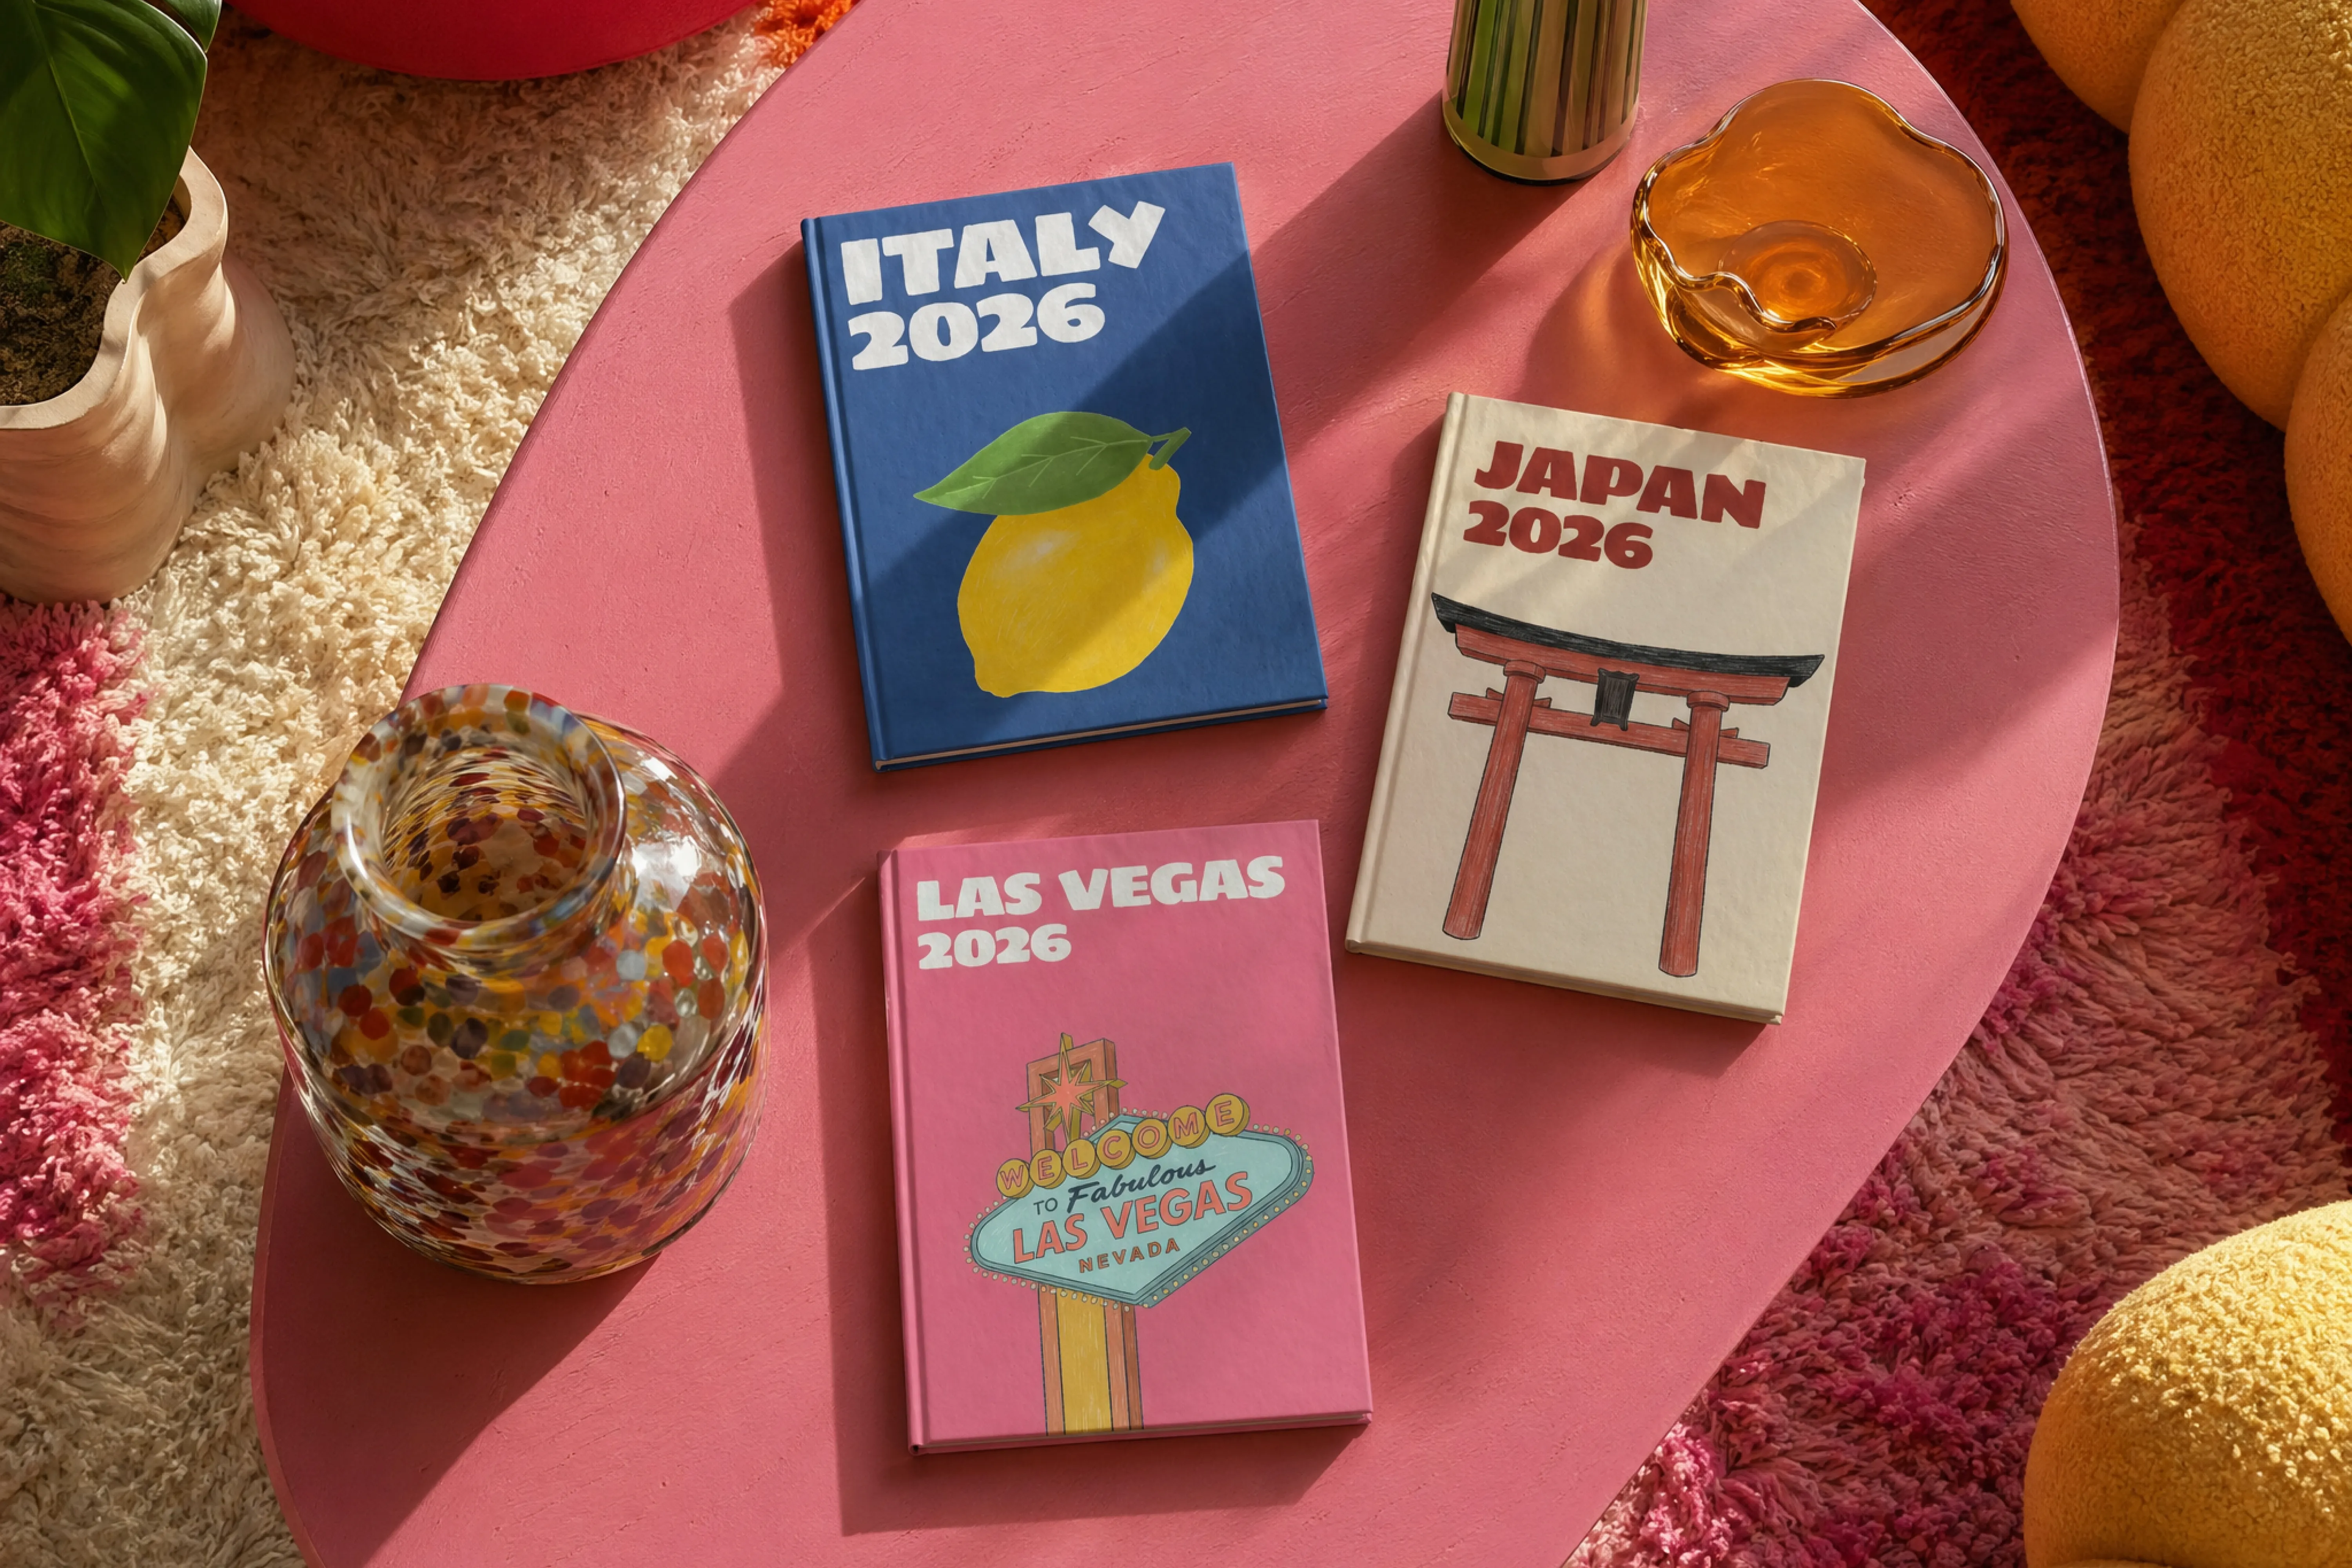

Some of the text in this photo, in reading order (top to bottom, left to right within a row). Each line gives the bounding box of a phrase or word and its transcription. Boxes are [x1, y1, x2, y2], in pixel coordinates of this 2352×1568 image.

[840, 201, 1166, 305] ITALY
[848, 283, 1105, 370] 2026
[1474, 440, 1767, 529] JAPAN
[1463, 499, 1653, 569] 2026
[917, 856, 1285, 921] LAS VEGAS
[917, 924, 1072, 969] 2026
[1000, 1100, 1236, 1190] WELCOME
[1013, 1172, 1253, 1264] LAS VEGAS
[1033, 1159, 1217, 1215] TO Fabulous
[1078, 1238, 1180, 1273] NEVADA
